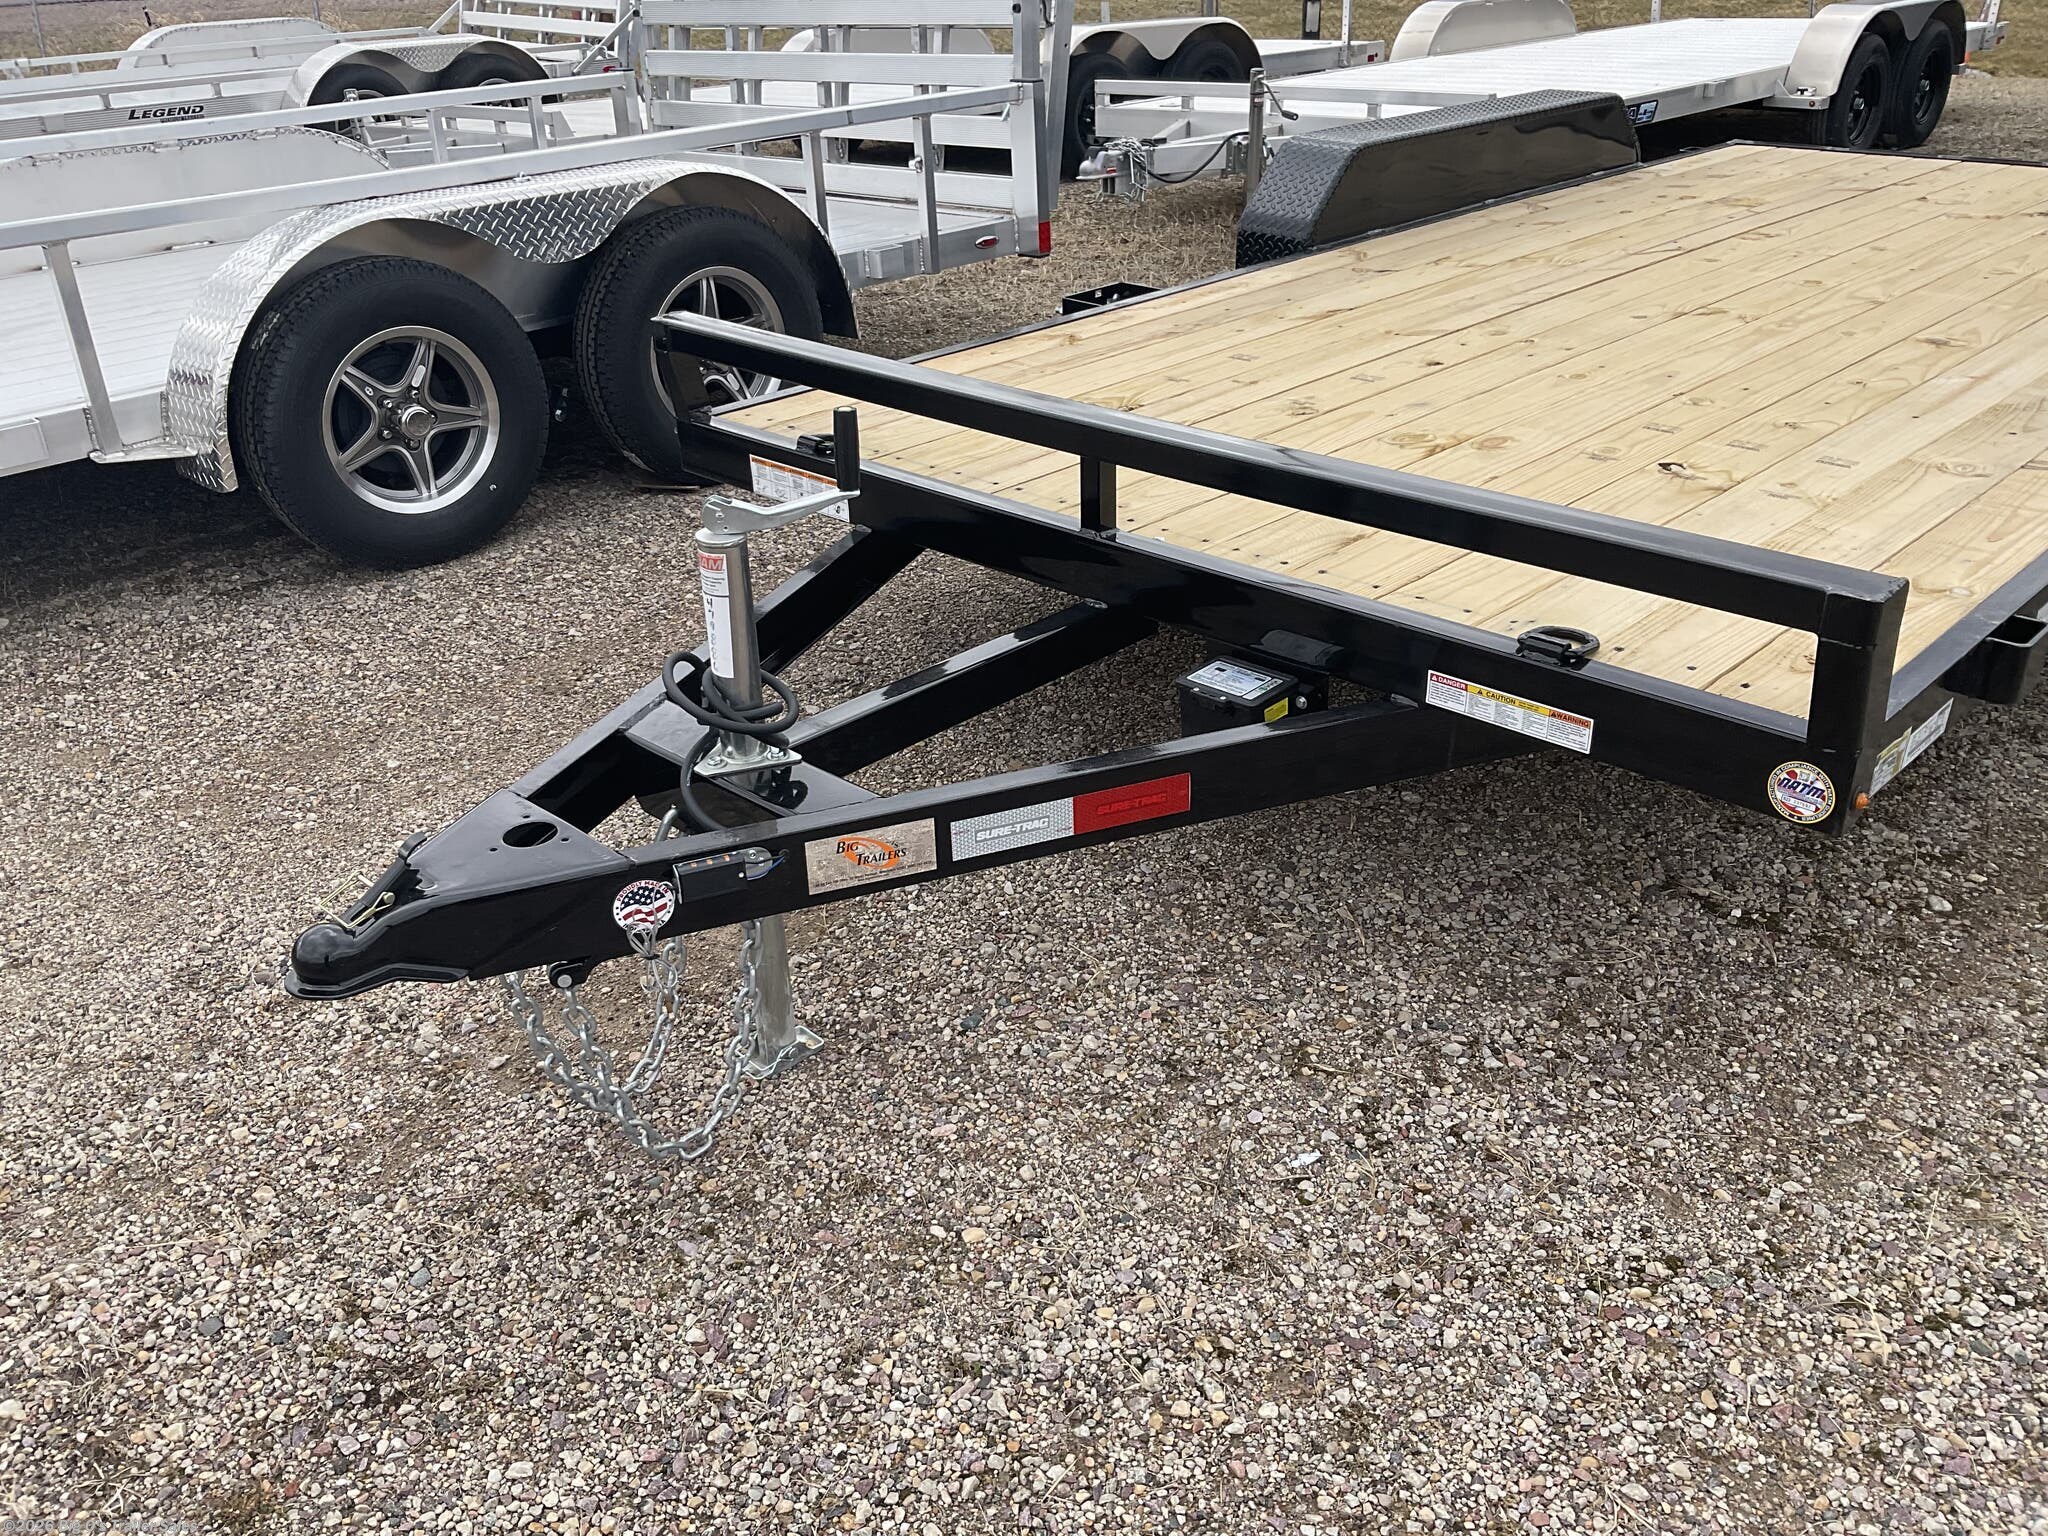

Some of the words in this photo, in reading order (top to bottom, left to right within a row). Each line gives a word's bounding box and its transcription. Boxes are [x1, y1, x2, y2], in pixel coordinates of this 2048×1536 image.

[128, 105, 204, 120] LEGEND
[1438, 676, 1466, 690] DANGER
[1486, 691, 1516, 705] CAUTION
[1556, 711, 1589, 727] WARNING
[976, 817, 1050, 841] SURE-TRAC
[856, 848, 907, 866] TRAILERS
[616, 881, 643, 902] PROUDLY
